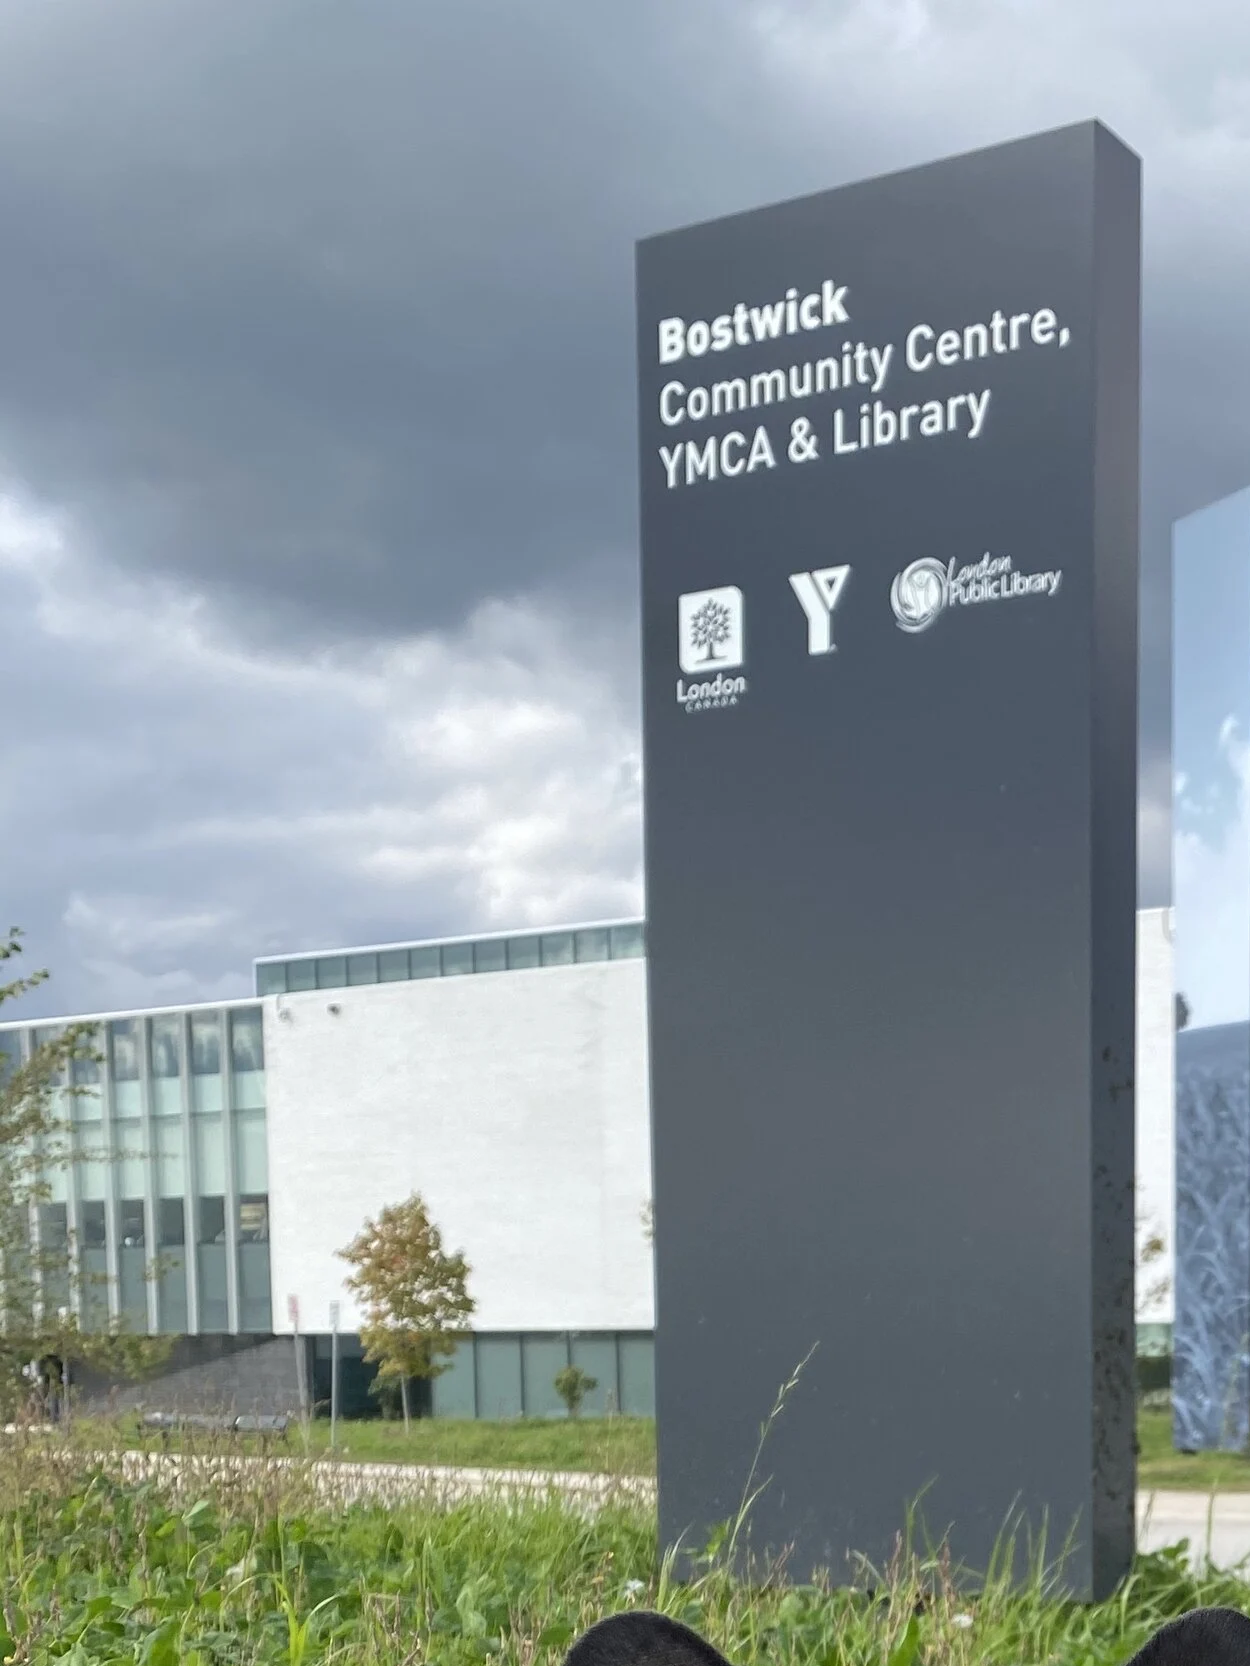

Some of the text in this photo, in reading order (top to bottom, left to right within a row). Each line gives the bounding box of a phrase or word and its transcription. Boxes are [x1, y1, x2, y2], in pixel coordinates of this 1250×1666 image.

[658, 279, 850, 364] Bostwick
[658, 307, 1071, 426] Community Centre,
[658, 389, 992, 488] YMCA & Library
[947, 552, 1012, 583] London
[949, 569, 1062, 606] Public Library
[788, 563, 851, 656] Y
[676, 672, 746, 703] London
[685, 695, 738, 713] CANADA
